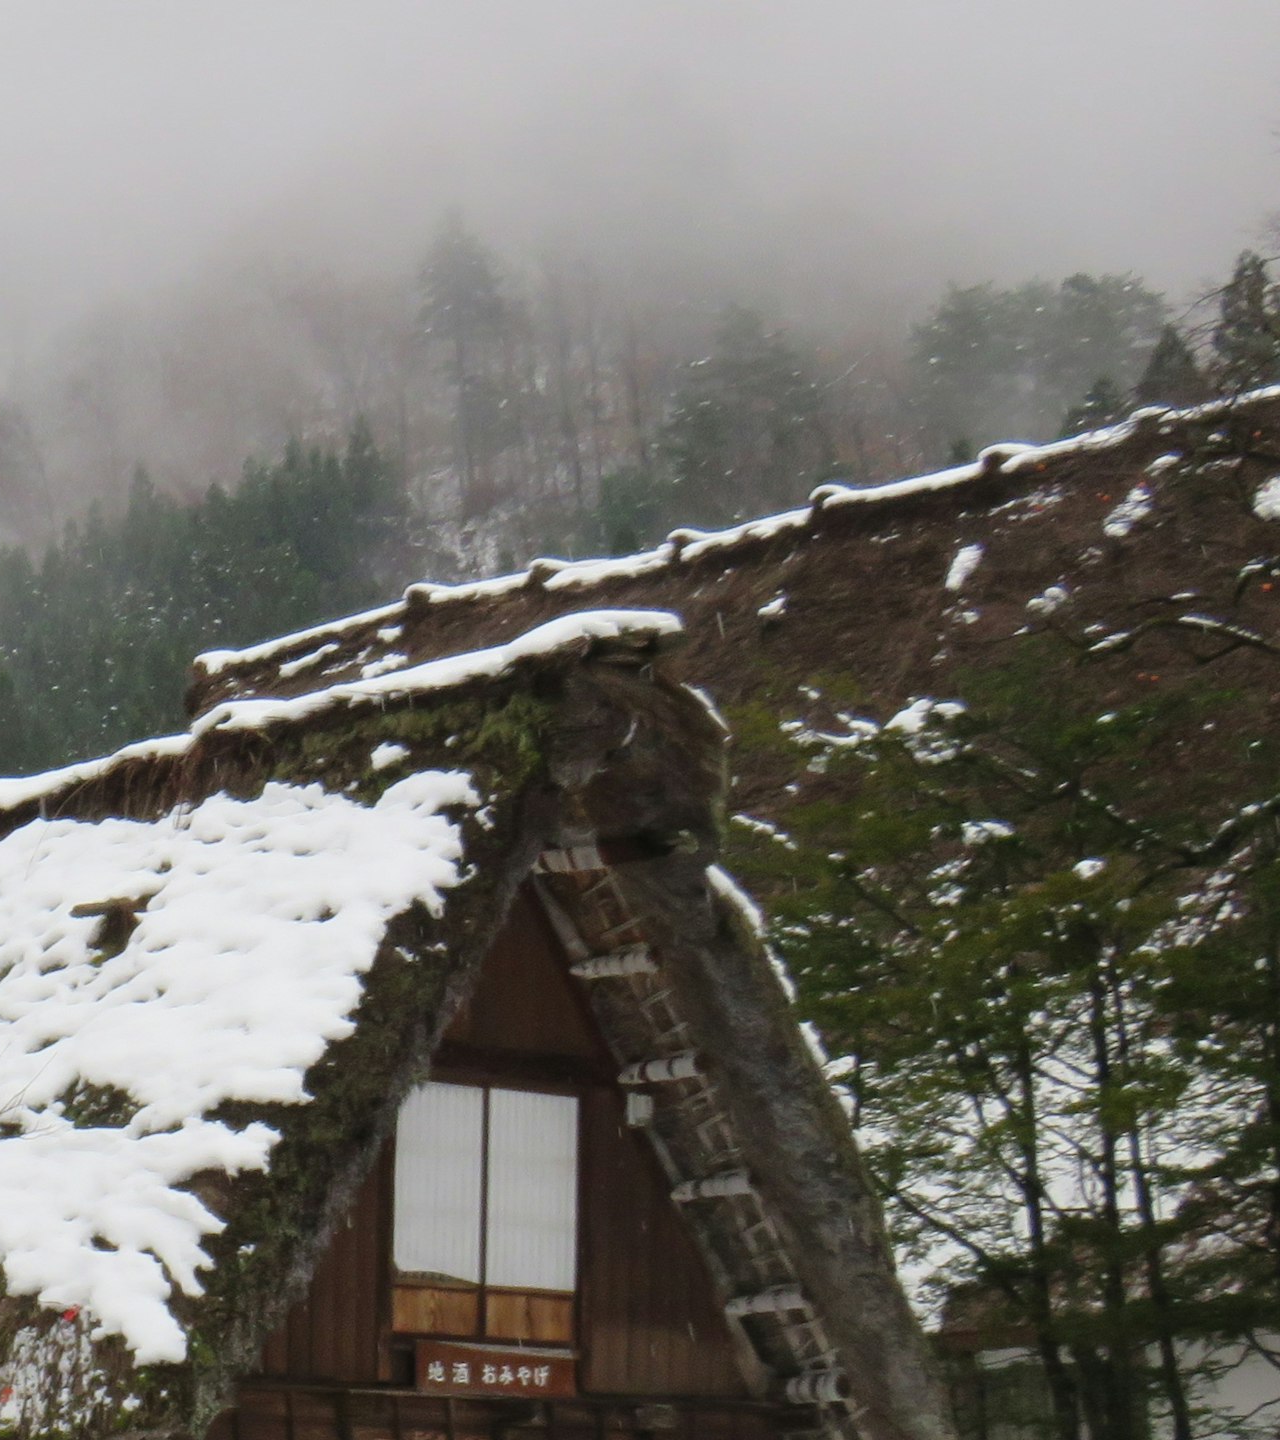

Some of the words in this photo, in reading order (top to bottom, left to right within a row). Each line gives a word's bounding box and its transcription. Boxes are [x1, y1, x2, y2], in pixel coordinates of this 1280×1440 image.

[428, 1360, 469, 1384] 地酒
[481, 1363, 549, 1387] おみやげ
